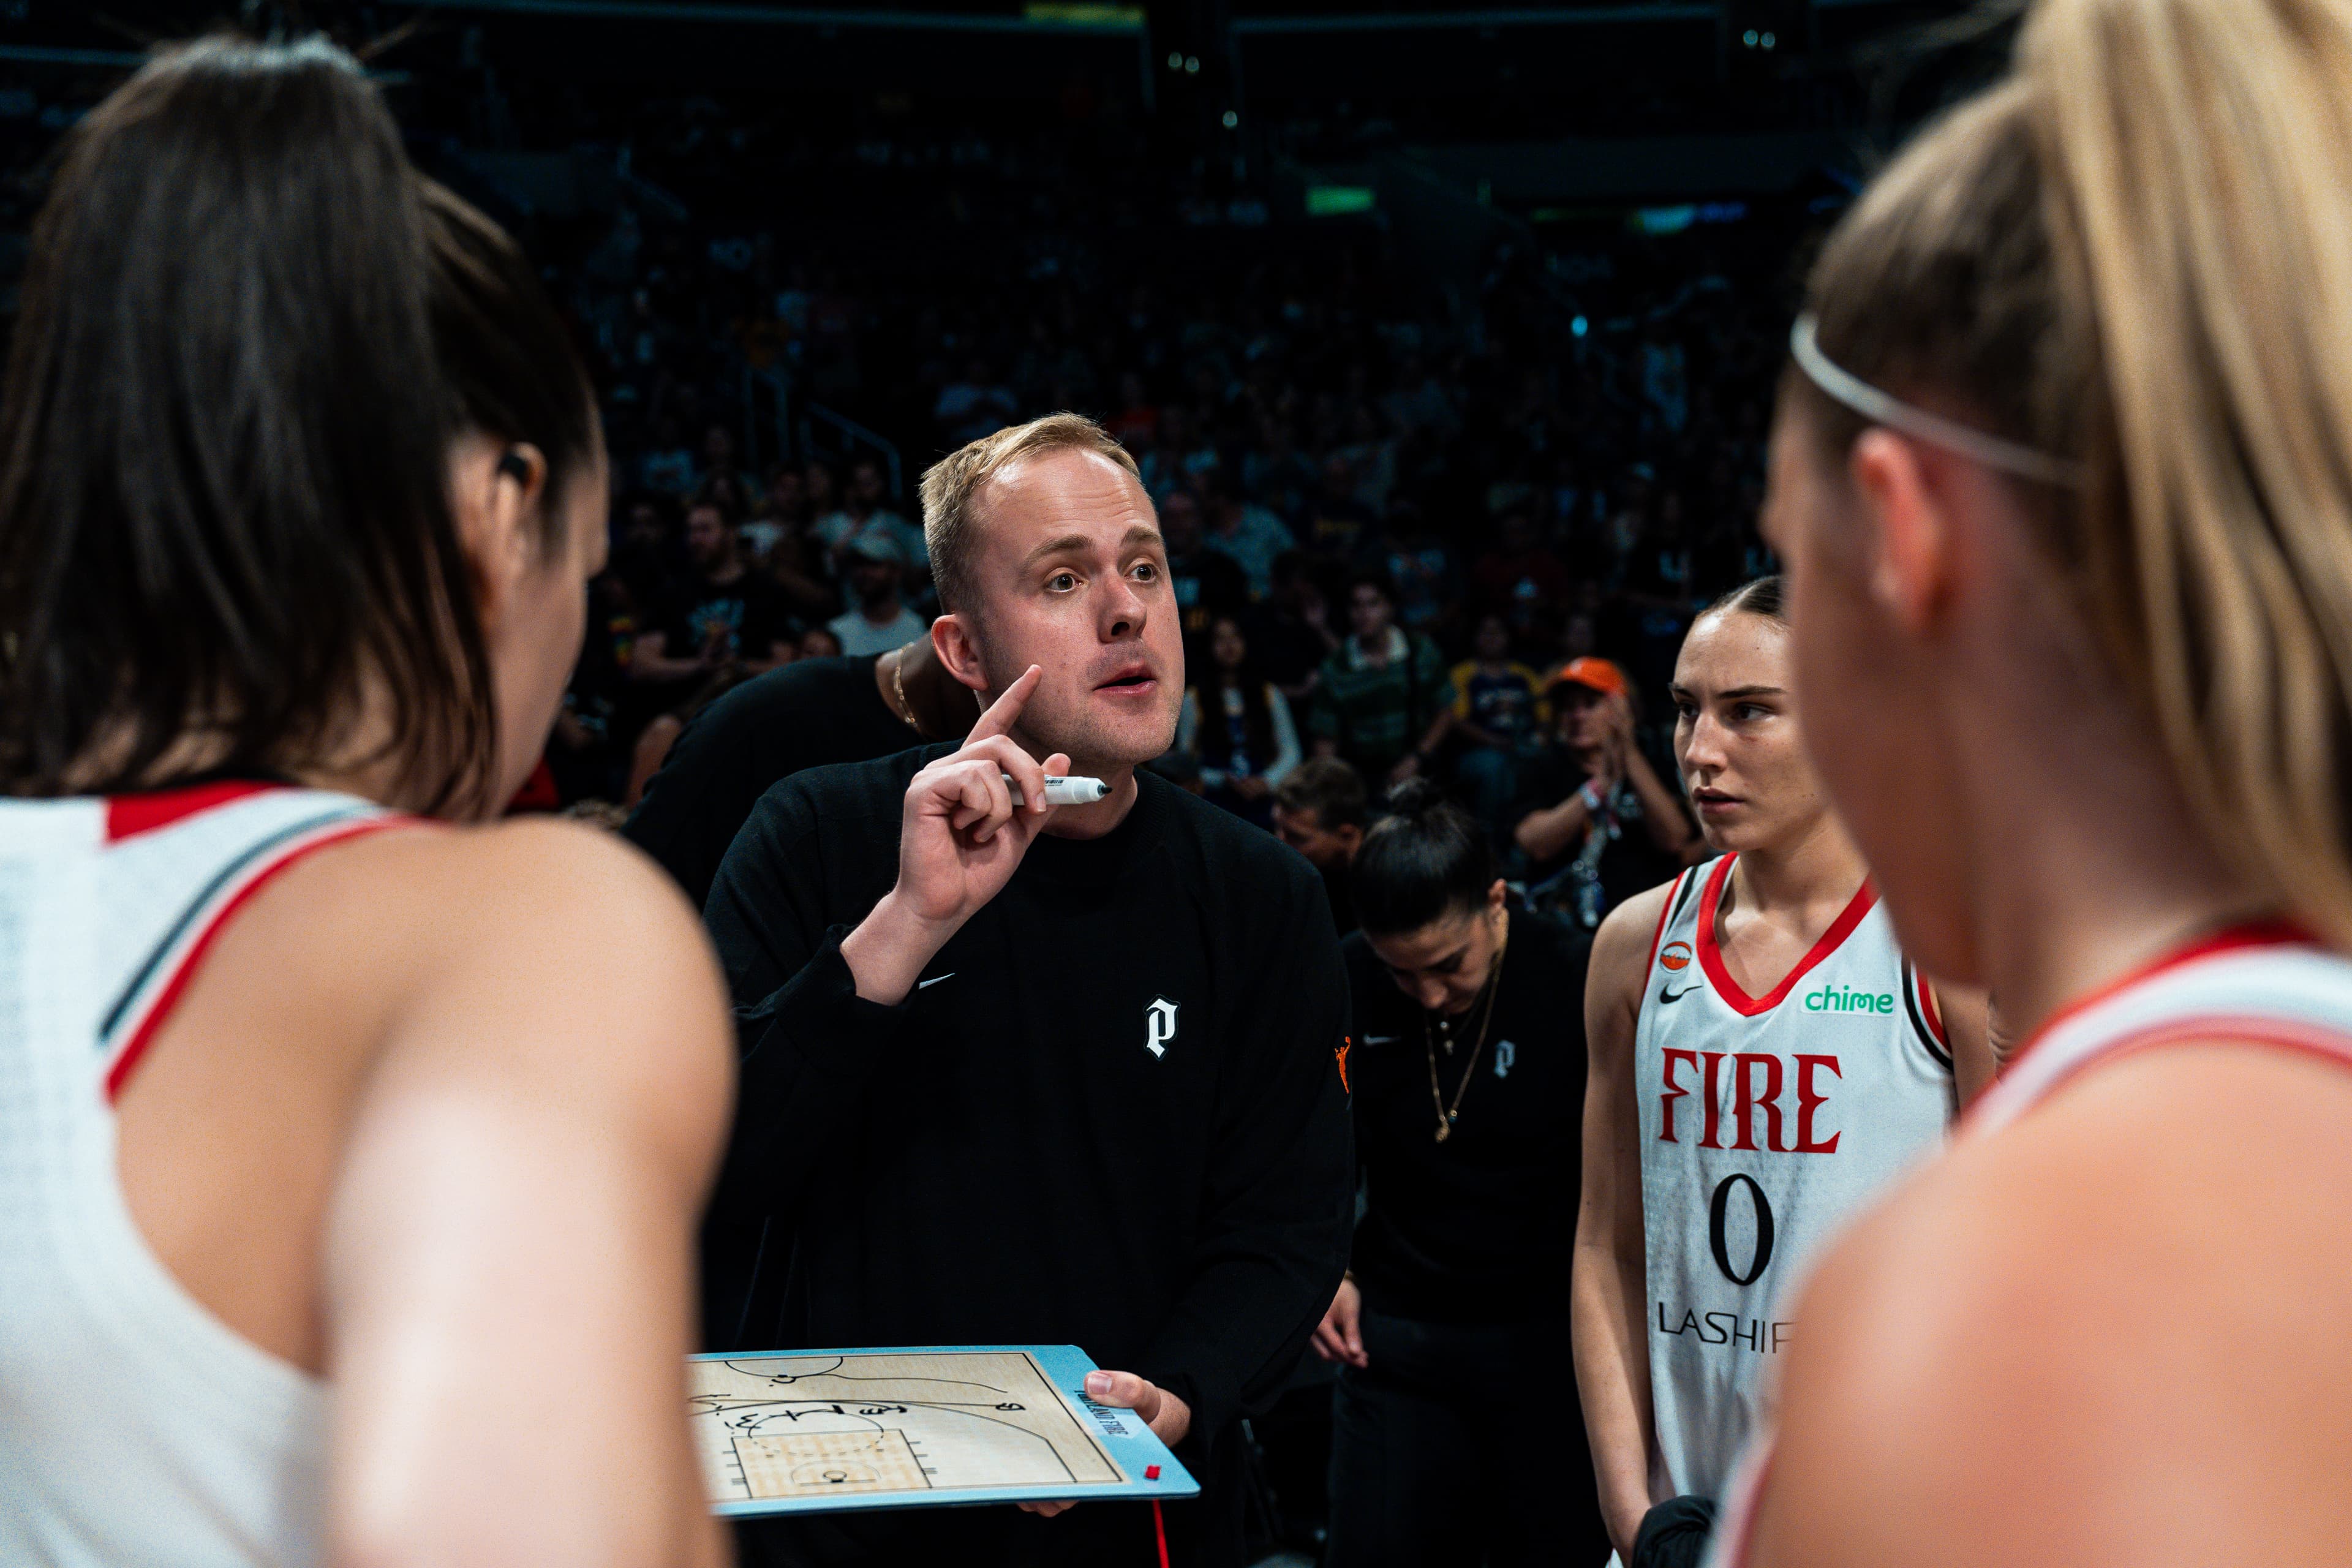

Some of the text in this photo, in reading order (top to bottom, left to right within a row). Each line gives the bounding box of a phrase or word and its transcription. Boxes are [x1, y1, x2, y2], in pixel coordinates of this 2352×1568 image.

[1805, 985, 1894, 1014] chime
[1659, 1047, 1843, 1154] FIRE
[1709, 1173, 1775, 1287] 0
